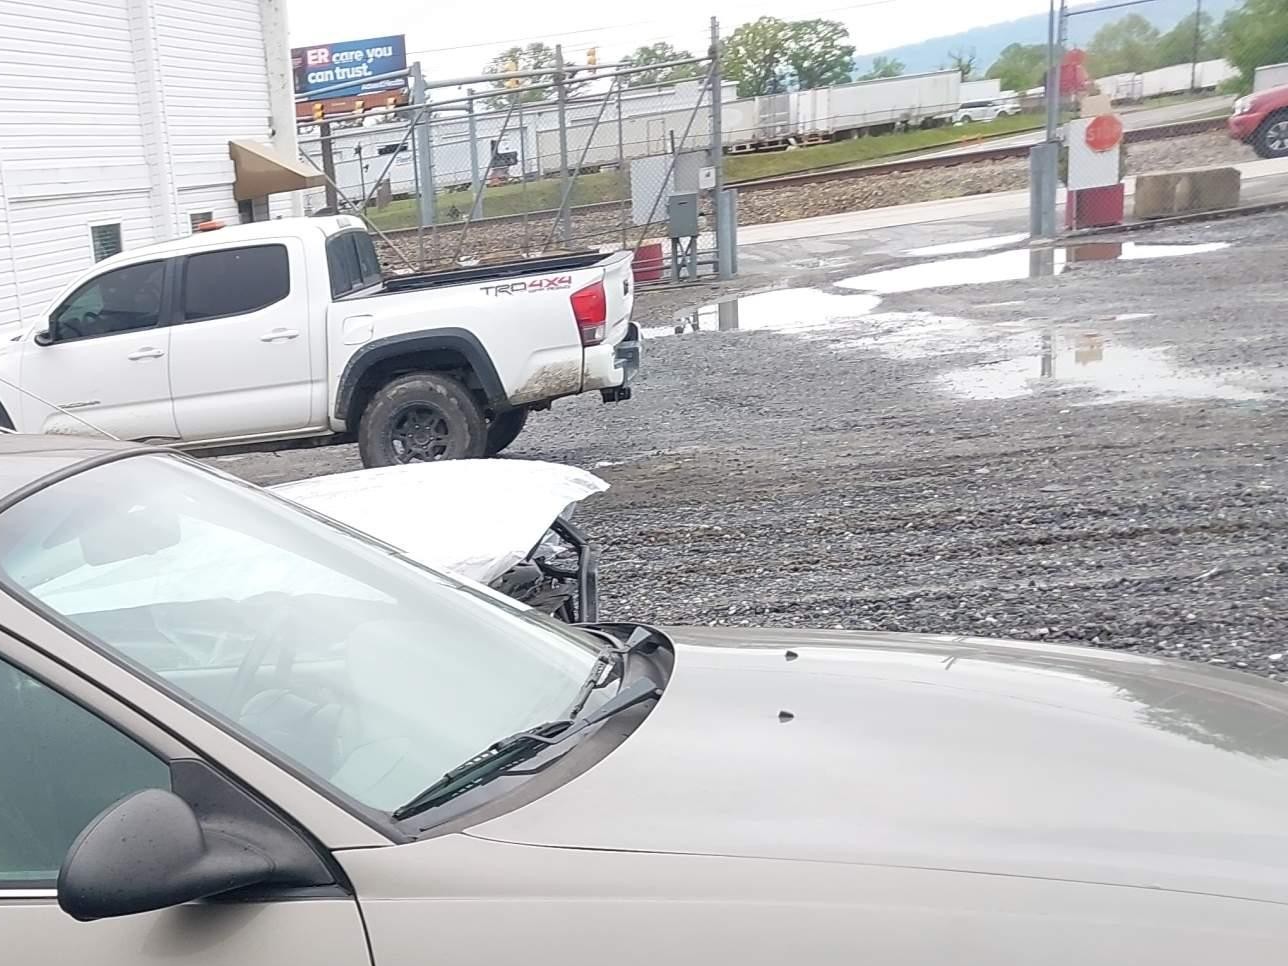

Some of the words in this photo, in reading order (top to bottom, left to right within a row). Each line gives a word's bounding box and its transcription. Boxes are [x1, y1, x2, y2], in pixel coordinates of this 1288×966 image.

[306, 48, 330, 65] ER
[332, 49, 363, 64] care
[366, 46, 392, 63] you
[307, 69, 334, 84] can
[334, 63, 373, 80] trust.
[480, 282, 527, 296] TRD
